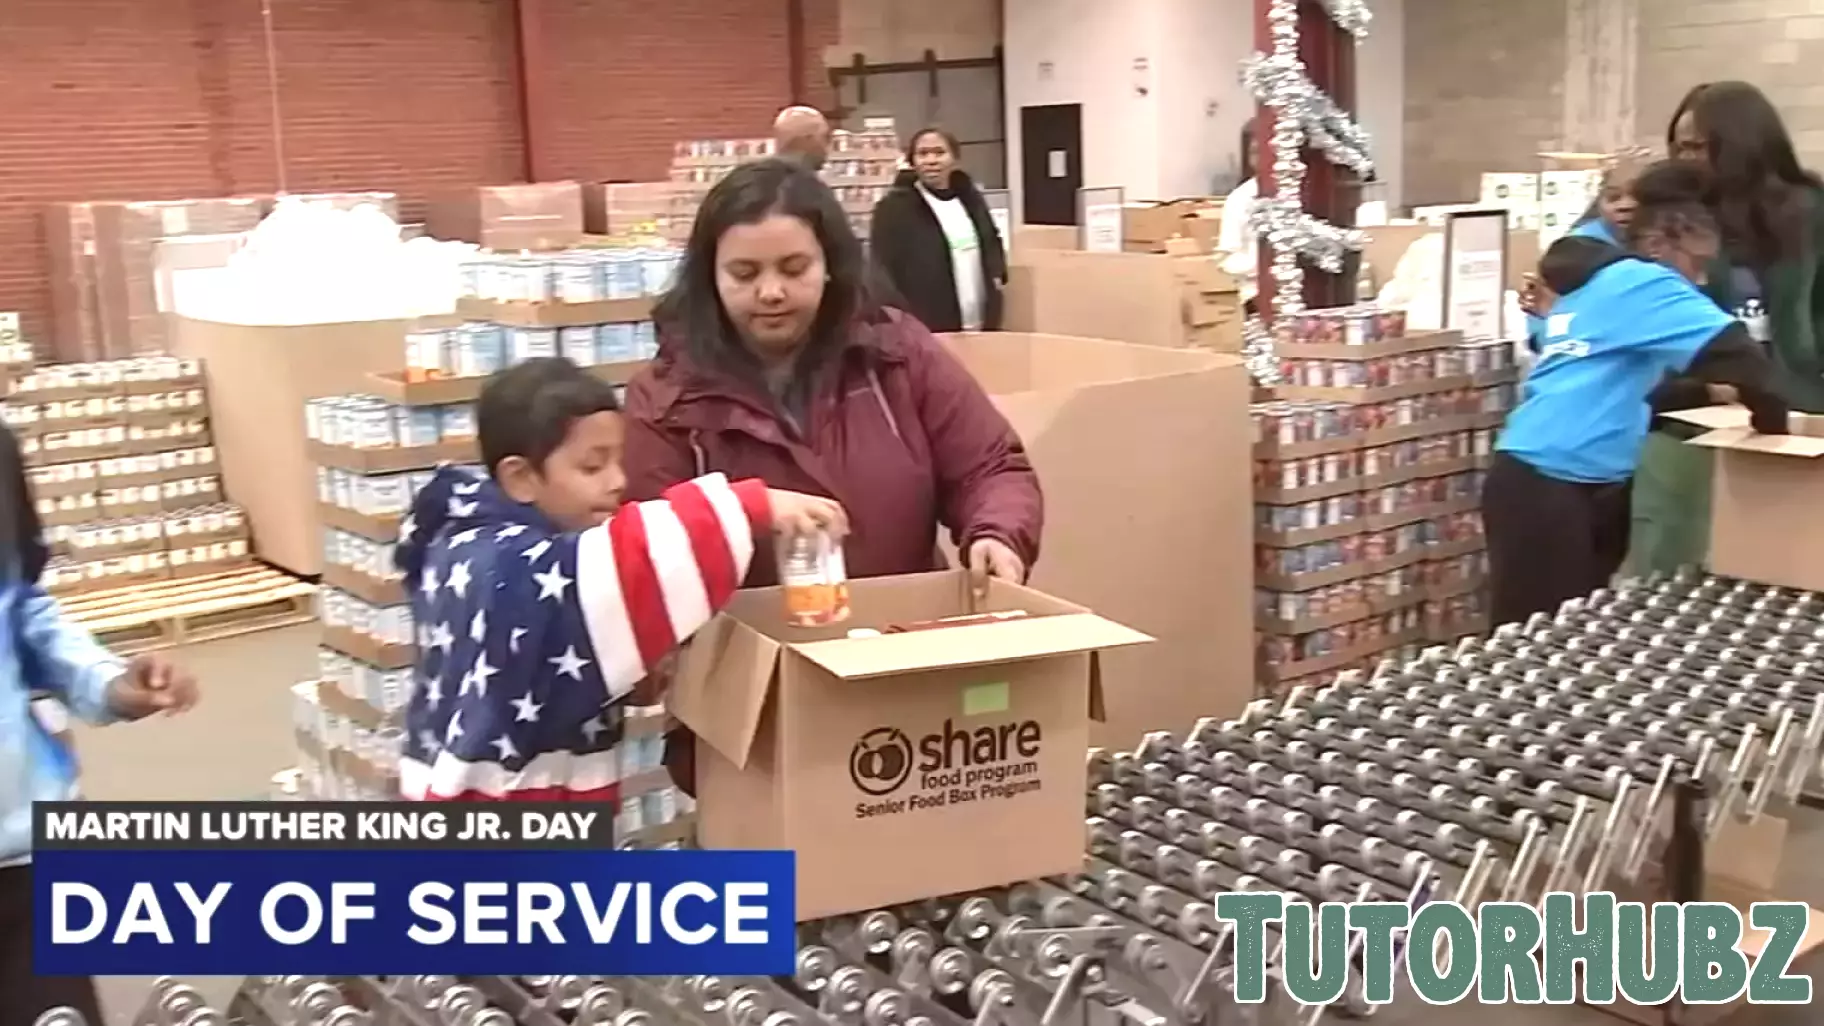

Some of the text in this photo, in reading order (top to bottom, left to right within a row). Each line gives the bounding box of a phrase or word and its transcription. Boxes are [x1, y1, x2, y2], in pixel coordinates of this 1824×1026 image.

[918, 718, 1041, 771] share
[921, 761, 1037, 789] food program
[855, 779, 1041, 819] Senior Food Box Program
